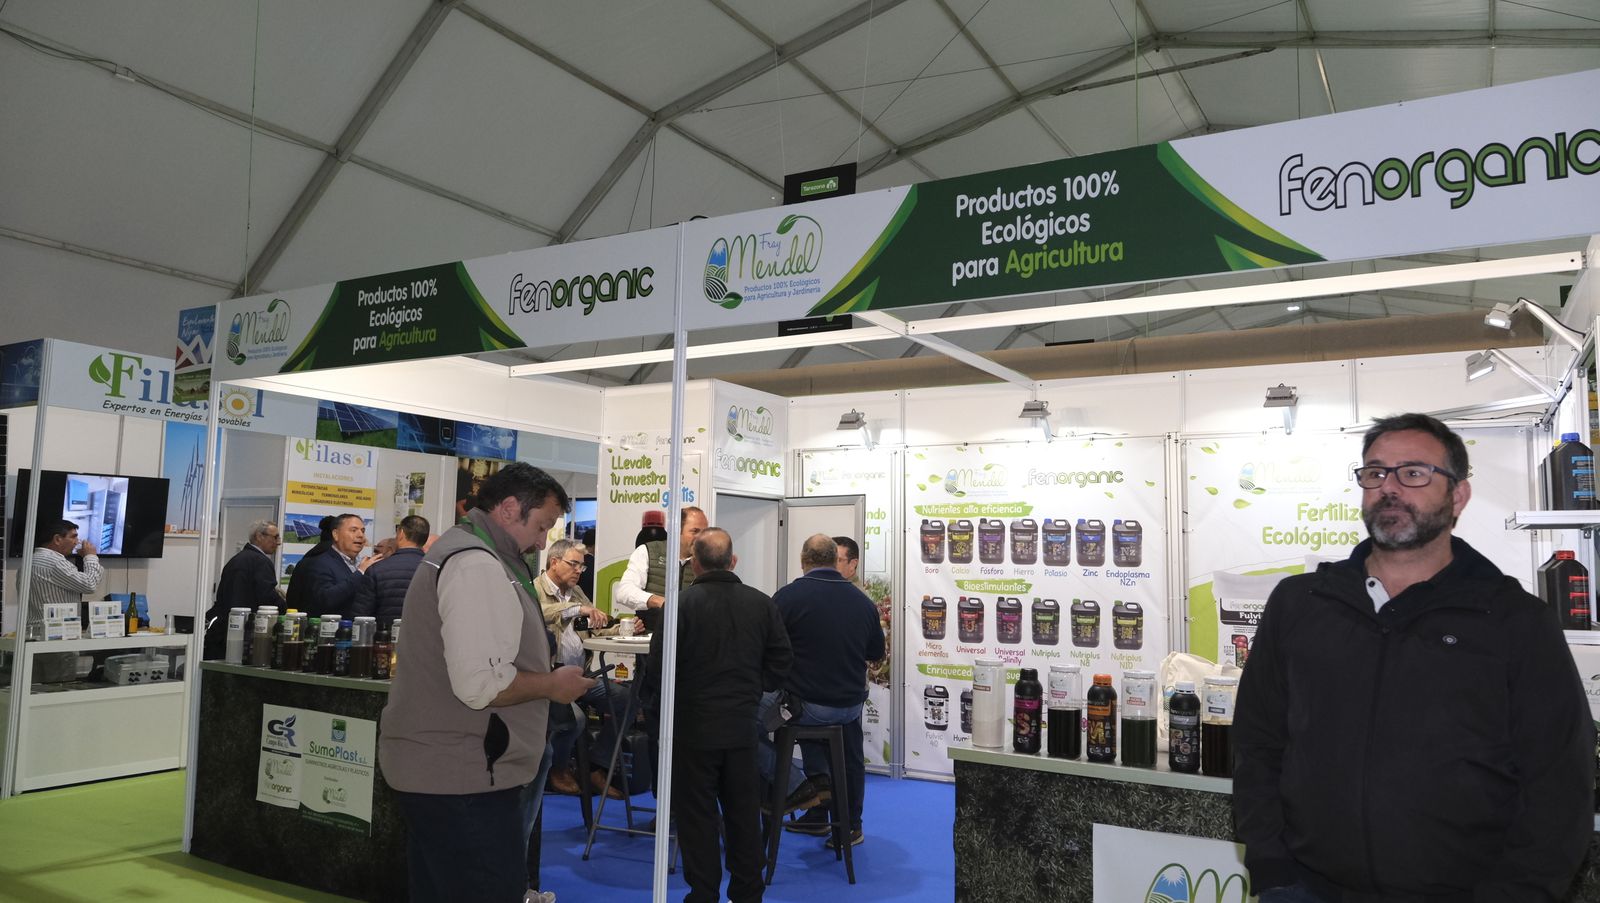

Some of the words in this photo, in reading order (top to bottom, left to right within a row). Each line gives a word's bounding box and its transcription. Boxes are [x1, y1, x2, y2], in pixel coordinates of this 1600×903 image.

[1279, 128, 1600, 216] fenorganic
[956, 182, 1057, 219] Productos
[1063, 169, 1120, 201] 100%
[981, 211, 1091, 246] Ecológicos
[759, 232, 781, 256] Fray
[704, 230, 822, 284] Mendel
[952, 255, 999, 286] para
[1004, 238, 1124, 279] Agricultura
[358, 284, 408, 307] Productos
[410, 278, 438, 298] 100%
[508, 266, 655, 316] fenorganic
[744, 283, 772, 293] Productos
[773, 280, 788, 289] 100%
[789, 278, 820, 289] Ecológicos
[744, 294, 756, 302] para
[757, 289, 787, 300] Agricultura
[227, 310, 288, 346] Mendel
[369, 306, 423, 332] Ecológicos
[353, 336, 378, 356] para
[379, 325, 437, 350] Agricultura
[102, 400, 147, 415] Expertos
[149, 407, 162, 416] en
[164, 409, 203, 422] Energías
[205, 415, 252, 428] novables
[729, 405, 774, 437] Mendel
[302, 439, 372, 468] Filasol
[611, 454, 652, 470] LLevate
[714, 447, 781, 479] fenorganic
[610, 471, 621, 486] tu
[623, 471, 667, 486] muestra
[1028, 468, 1124, 488] fenorganic
[609, 489, 660, 504] Universal
[662, 486, 695, 508] gtis
[922, 504, 961, 514] Nutrientes
[963, 505, 979, 514] alta
[981, 504, 1023, 514] eficiencia
[1262, 526, 1360, 551] Ecológicos
[980, 566, 1004, 575] Fósforo
[1014, 568, 1035, 576] Hierro
[1044, 569, 1068, 577] Potasio
[1082, 569, 1099, 577] Zinc
[1105, 570, 1151, 579] Endoplasma
[1120, 578, 1136, 587] NZn
[963, 581, 1027, 593] Bioestimulantes
[1239, 612, 1262, 620] Fulvi
[918, 650, 949, 658] elementos
[925, 641, 943, 650] Micro
[956, 645, 986, 655] Universal
[994, 648, 1026, 657] Universal
[1031, 648, 1061, 659] Nutriplus
[1070, 650, 1100, 661] Nutriplus
[1111, 652, 1142, 663] Nutriplus
[925, 731, 943, 740] Fulvic
[309, 740, 359, 763] SumaPlast
